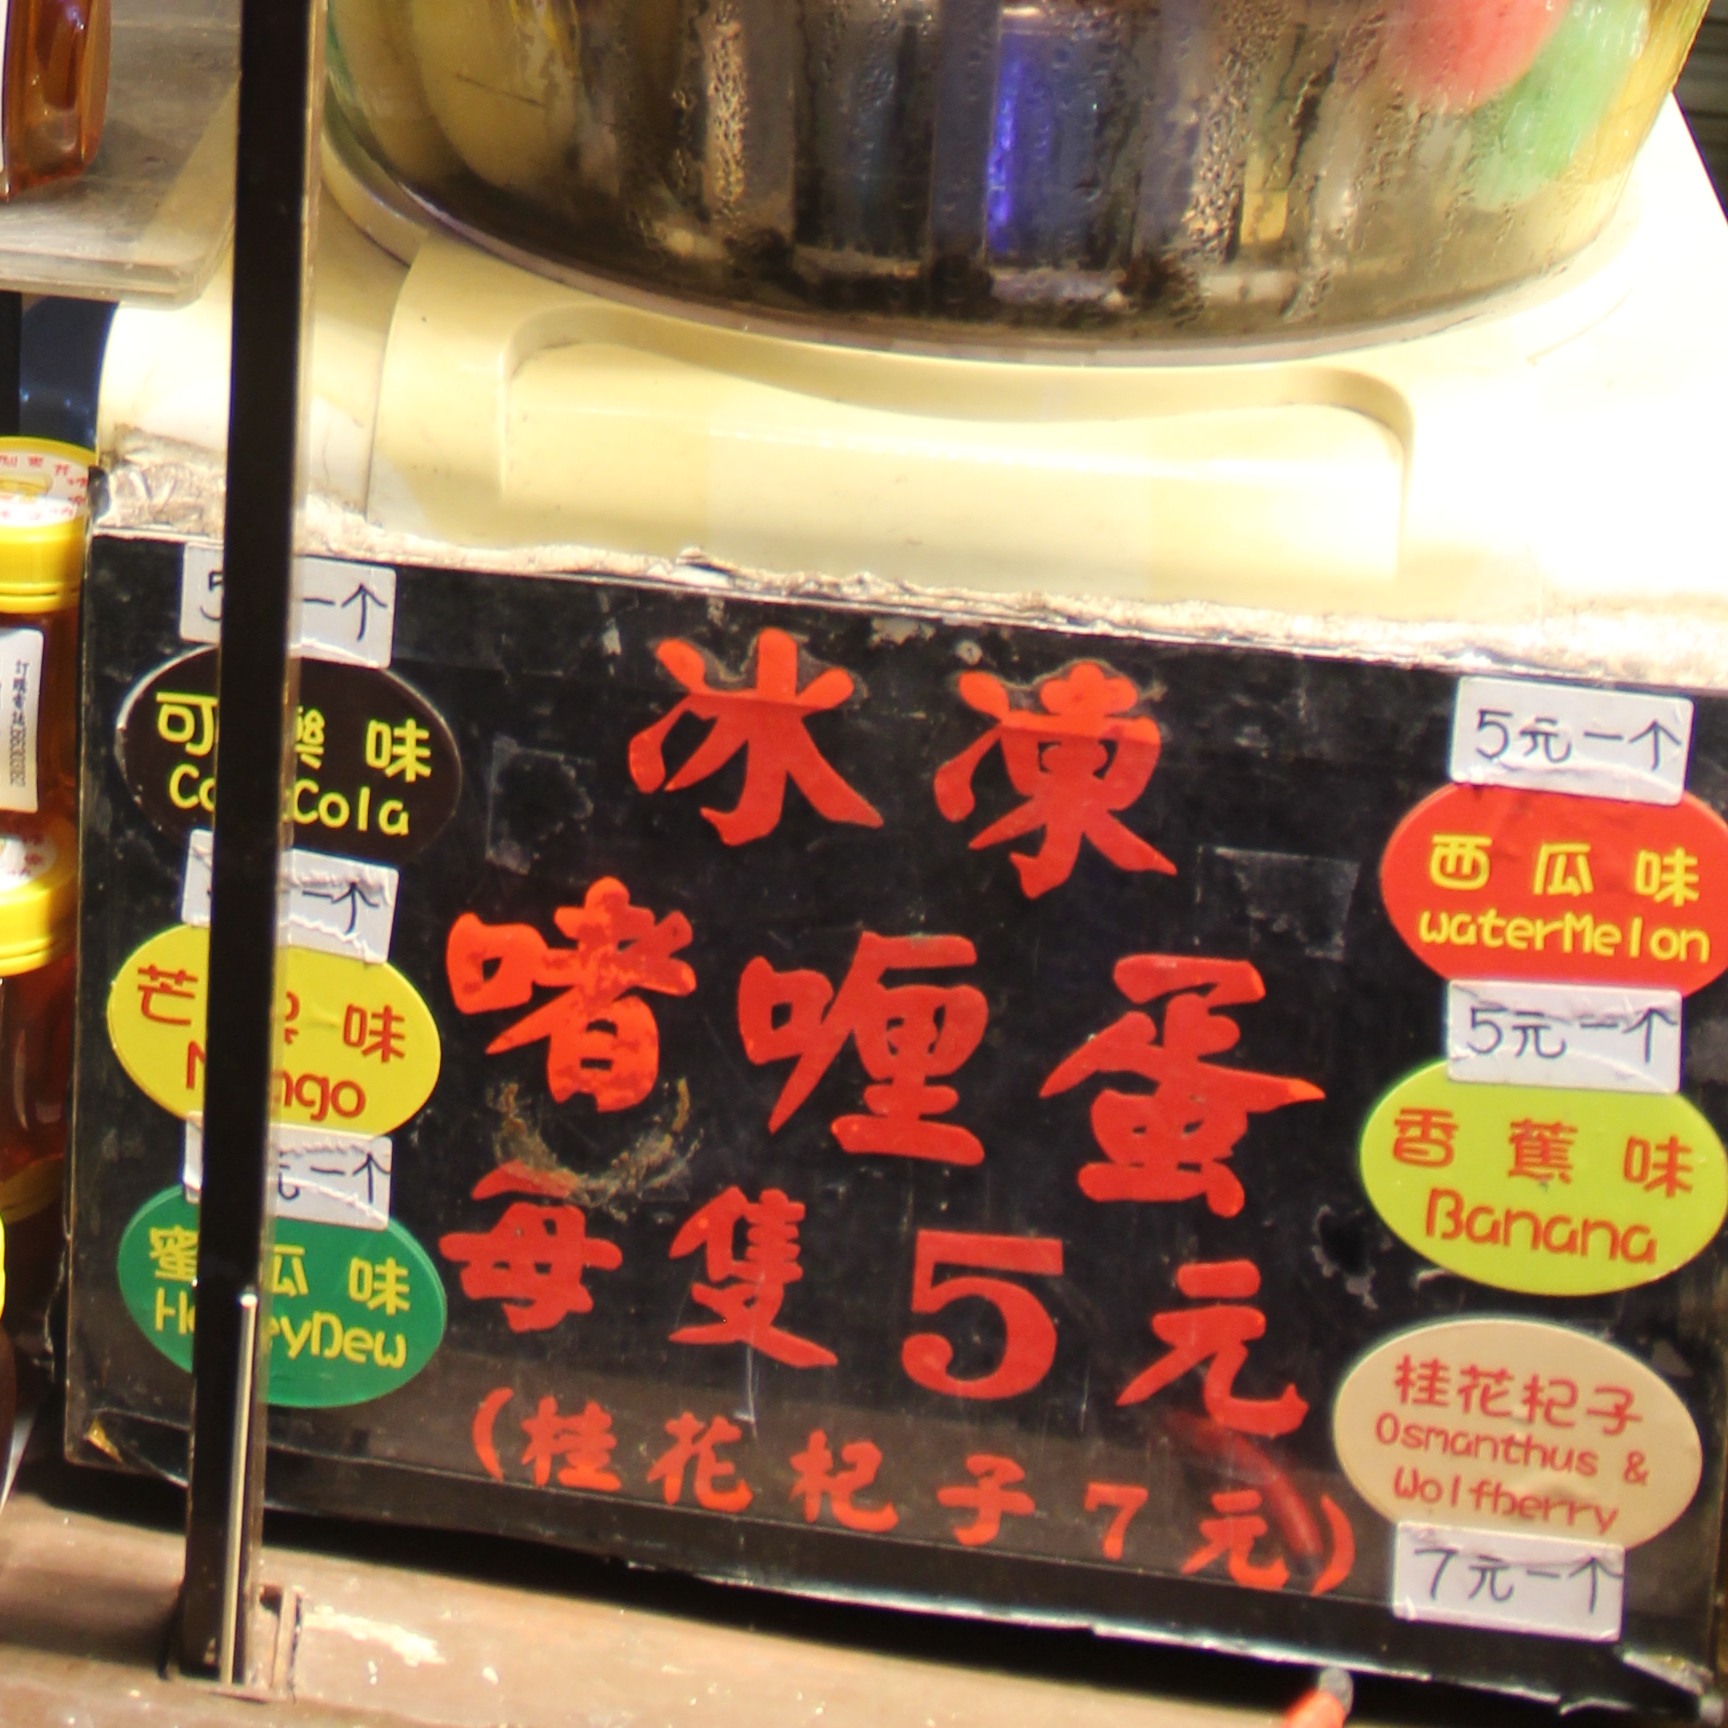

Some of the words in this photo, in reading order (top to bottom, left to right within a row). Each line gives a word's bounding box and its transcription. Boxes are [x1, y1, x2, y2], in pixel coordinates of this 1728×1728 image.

[169, 763, 410, 837] CoCola
[629, 627, 1178, 899] 冰凍
[1428, 832, 1701, 908] 西瓜味
[1417, 907, 1711, 965] waterMelon
[137, 964, 406, 1063] 芒味
[446, 876, 1326, 1217] 啫喱蛋
[186, 1040, 367, 1122] Mngo
[1392, 1106, 1694, 1200] 香蕉味
[1425, 1187, 1659, 1266] Banana
[155, 1286, 408, 1370] HyDew
[440, 1159, 1309, 1437] 每隻5元
[1393, 1352, 1644, 1436] 桂花杞子
[1374, 1411, 1599, 1477] Osmanthus
[1623, 1449, 1650, 1487] &
[1393, 1465, 1620, 1534] Wolfberry
